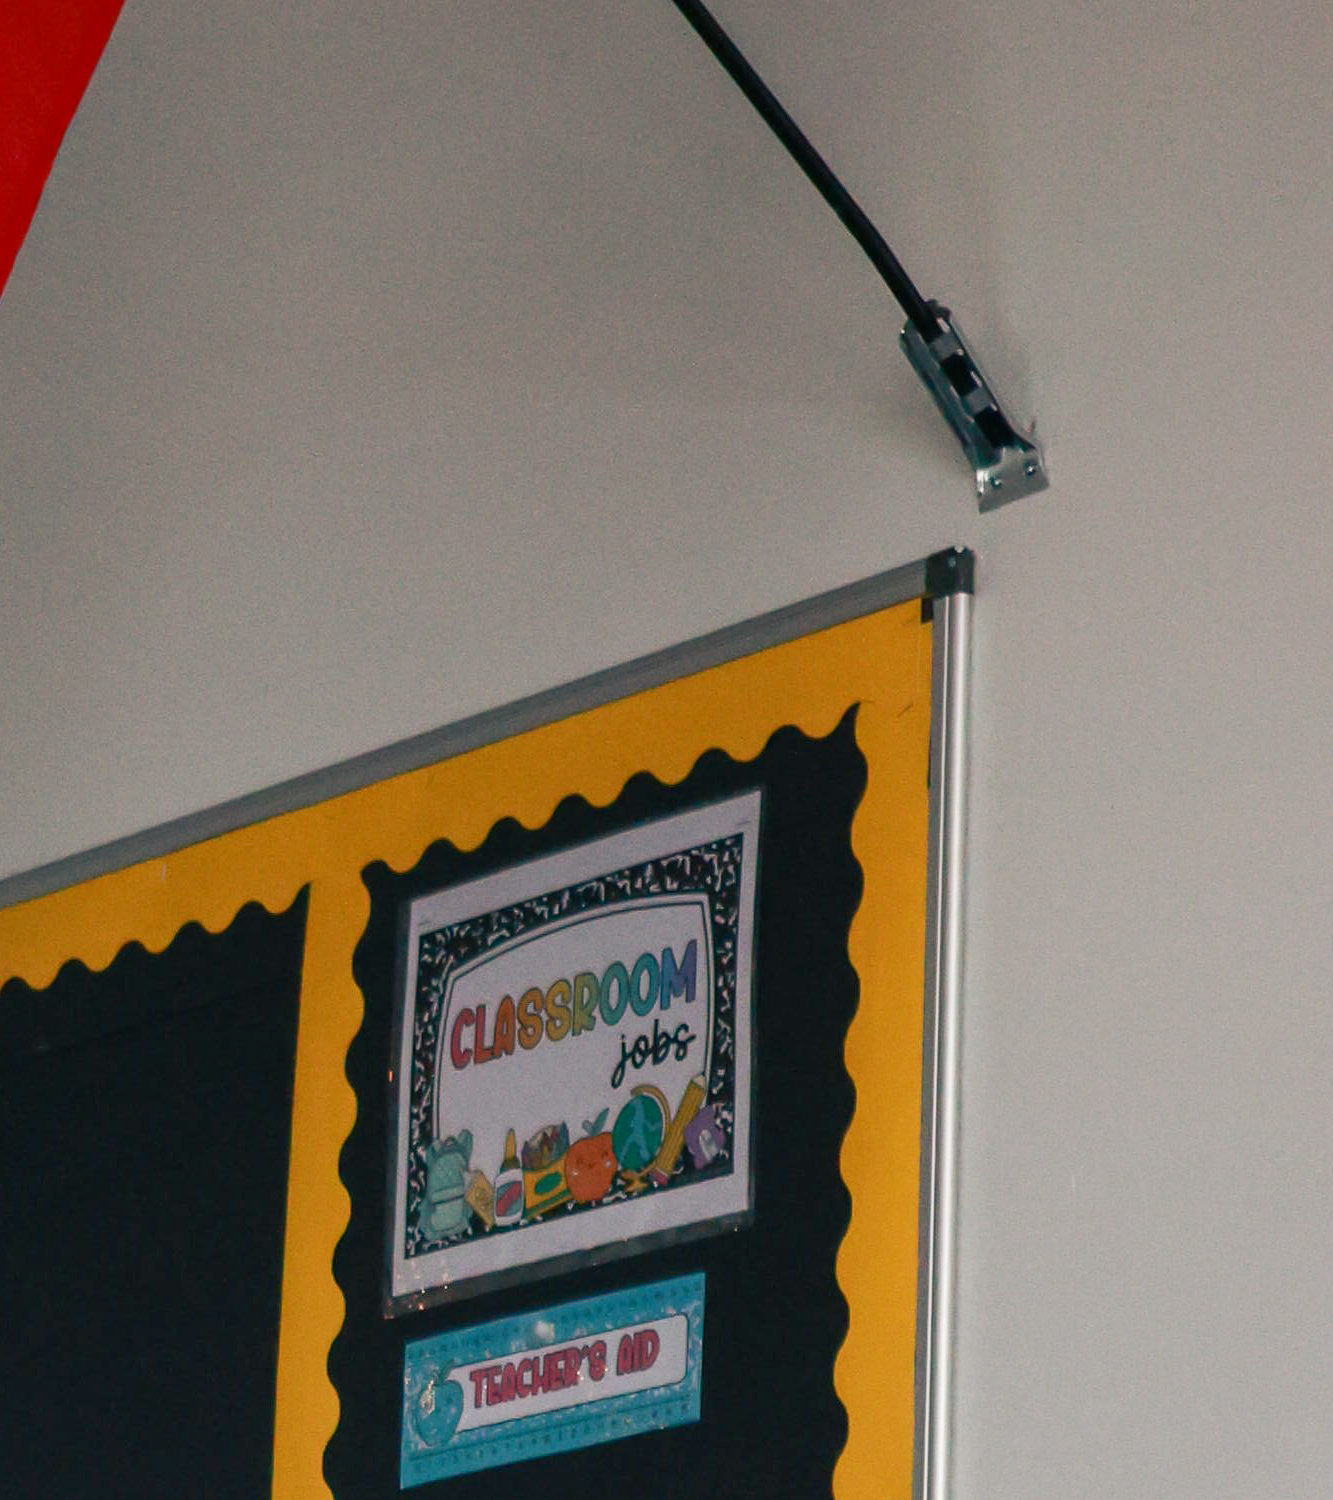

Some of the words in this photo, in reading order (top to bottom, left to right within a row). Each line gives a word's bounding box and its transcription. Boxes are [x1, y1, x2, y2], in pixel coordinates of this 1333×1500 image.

[450, 939, 698, 1071] CLASSROOM
[610, 1017, 697, 1089] jobs
[470, 1340, 607, 1409] TEACHER'S
[616, 1329, 660, 1376] AID
